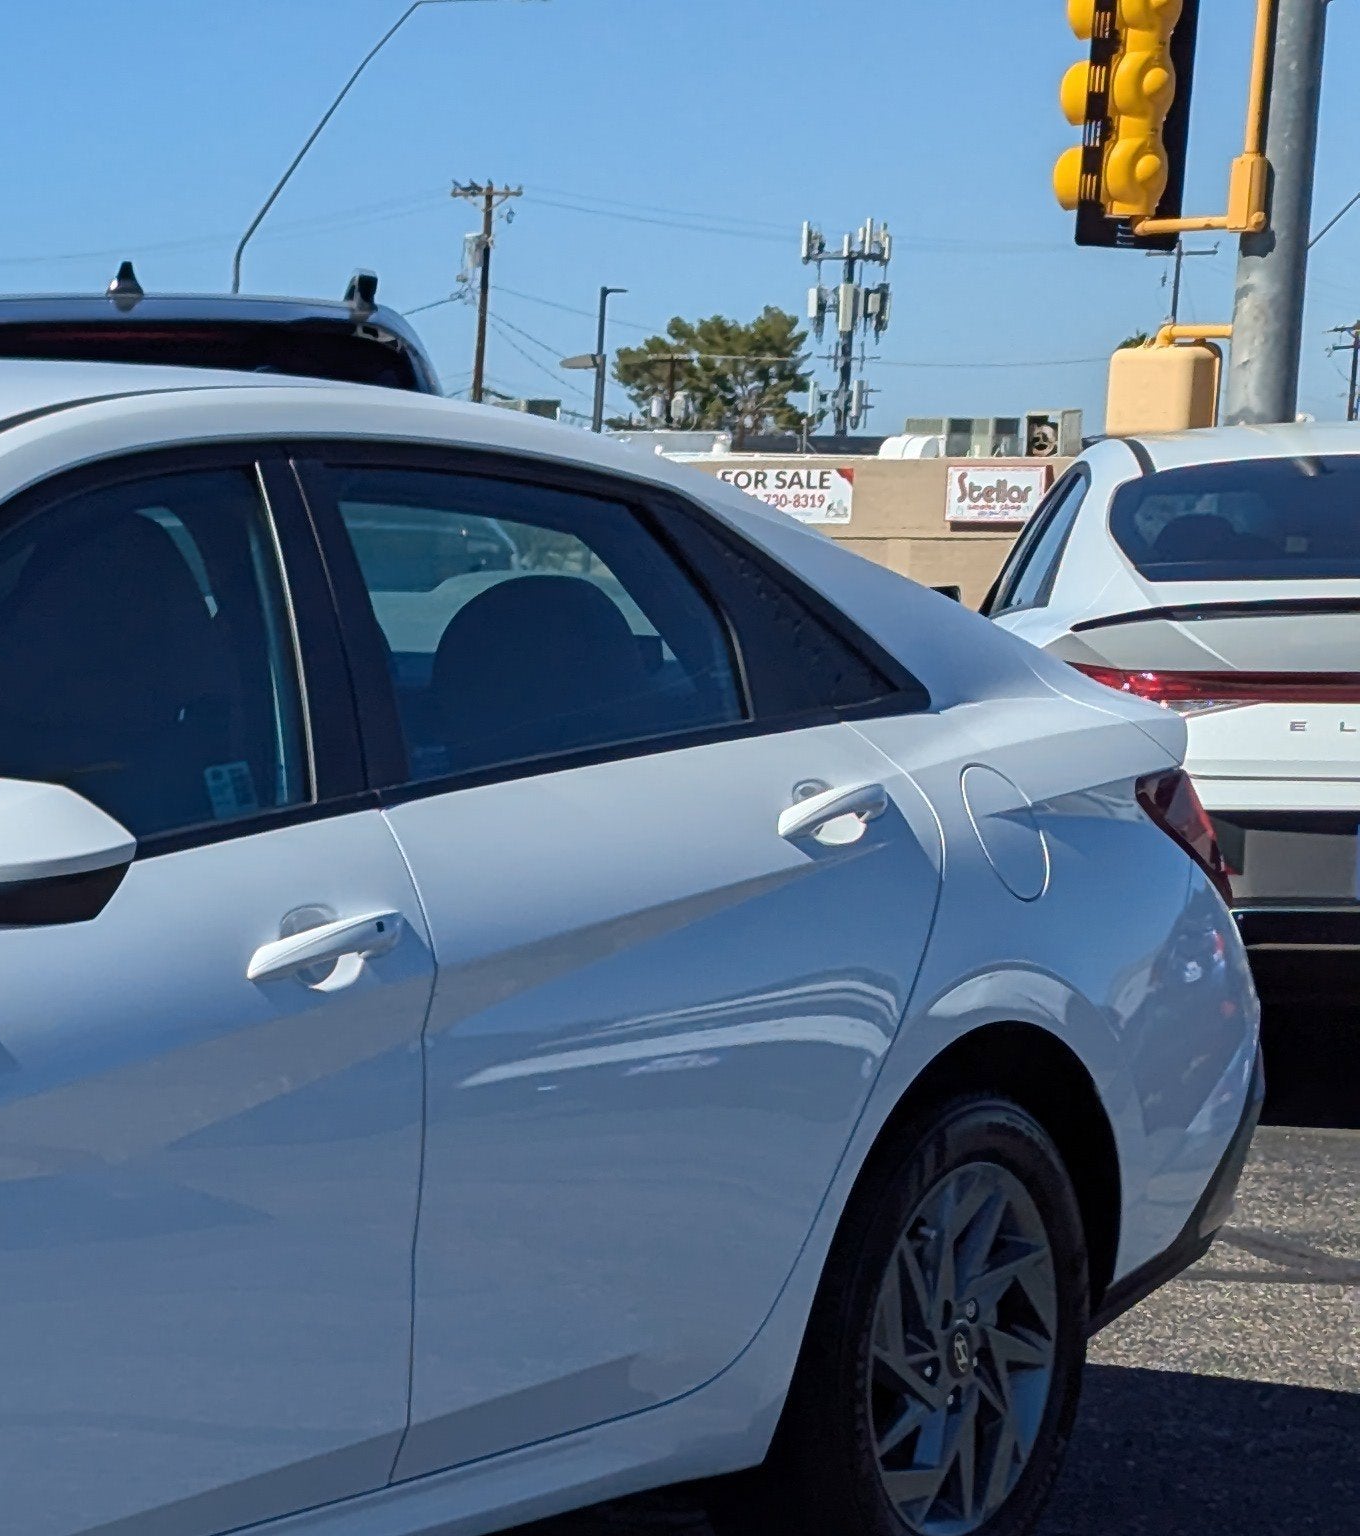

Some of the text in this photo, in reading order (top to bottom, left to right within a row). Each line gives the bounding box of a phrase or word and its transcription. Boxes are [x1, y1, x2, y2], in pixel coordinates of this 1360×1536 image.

[721, 470, 832, 490] FOR SALE
[956, 471, 1033, 503] Stellar
